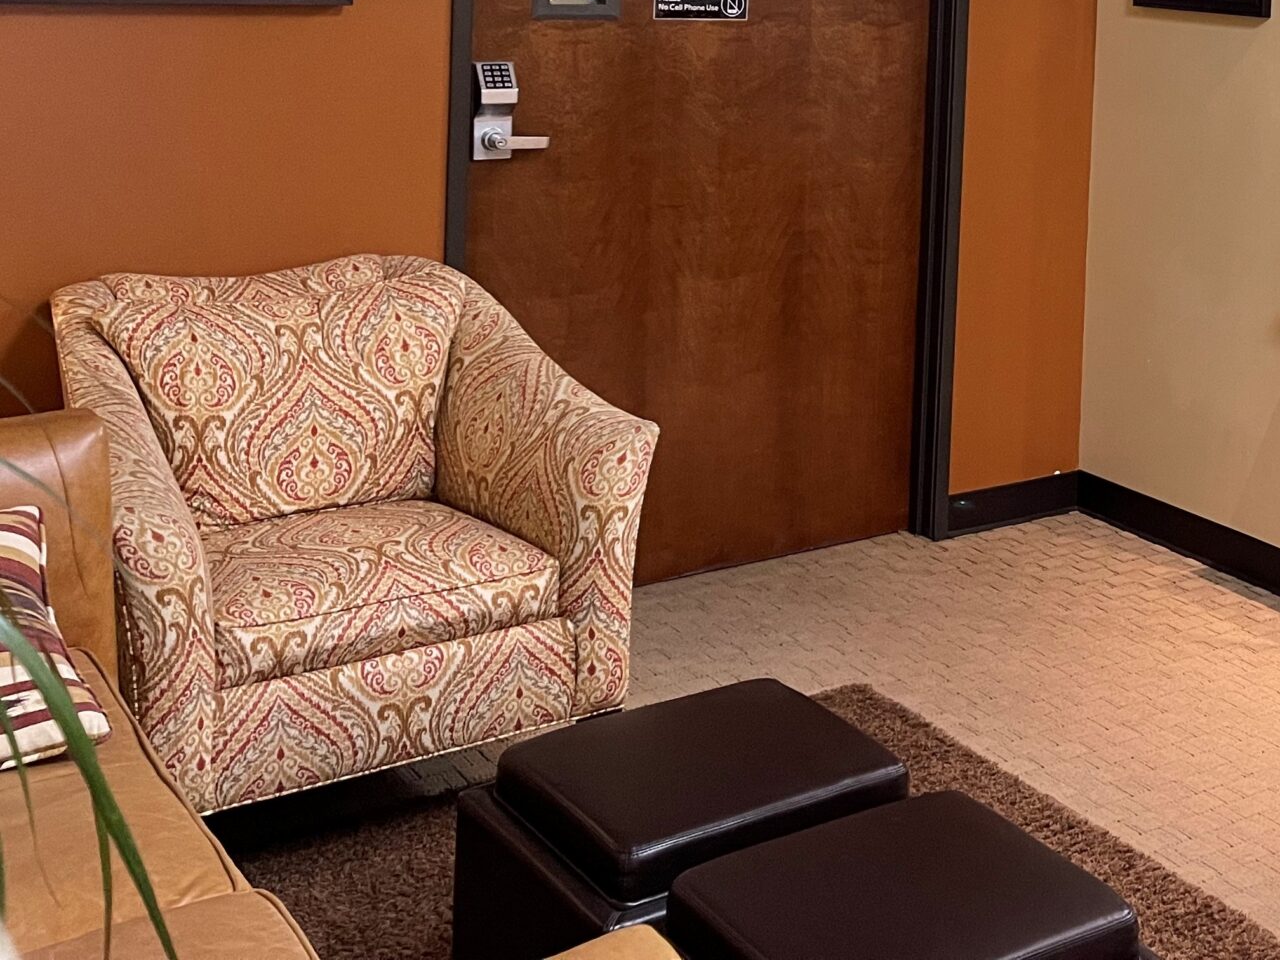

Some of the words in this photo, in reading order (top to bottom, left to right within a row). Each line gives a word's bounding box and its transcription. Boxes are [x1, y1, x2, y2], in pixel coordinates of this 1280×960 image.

[658, 3, 669, 11] No
[669, 3, 683, 11] Cell
[684, 3, 705, 11] Phone
[706, 4, 719, 12] Use
